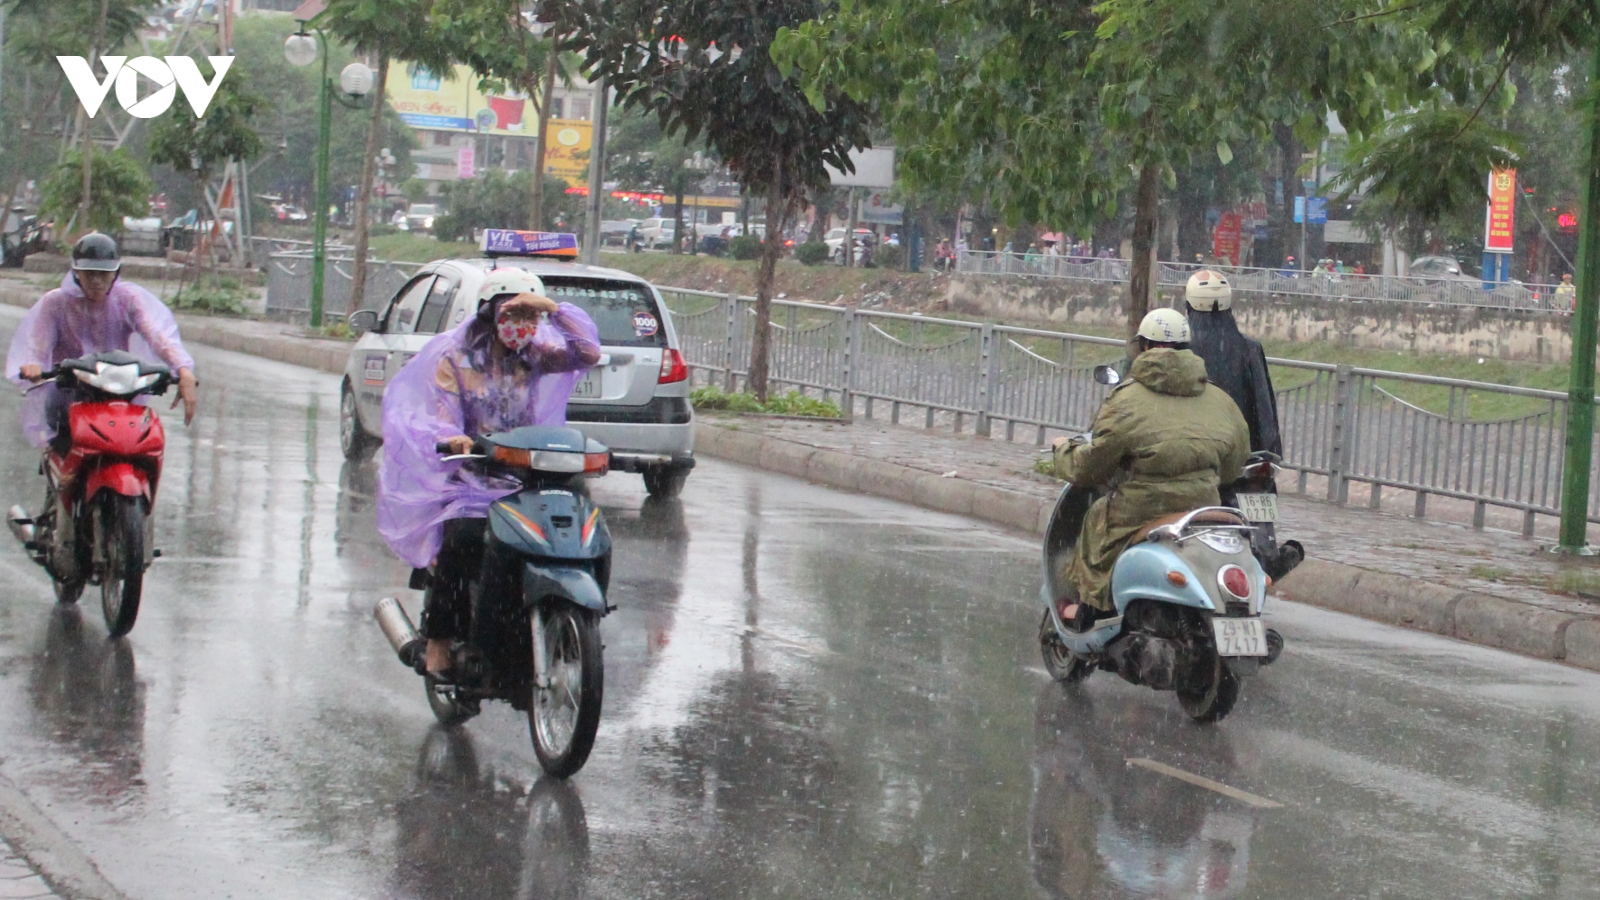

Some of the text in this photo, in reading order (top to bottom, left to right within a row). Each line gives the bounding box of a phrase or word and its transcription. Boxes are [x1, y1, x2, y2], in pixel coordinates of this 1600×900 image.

[491, 232, 514, 242] VIC
[634, 316, 657, 329] 1000
[540, 489, 573, 497] SUZUKI
[1244, 495, 1272, 507] 16-R6
[1221, 620, 1257, 636] 29-N1
[1224, 637, 1258, 655] 7417
